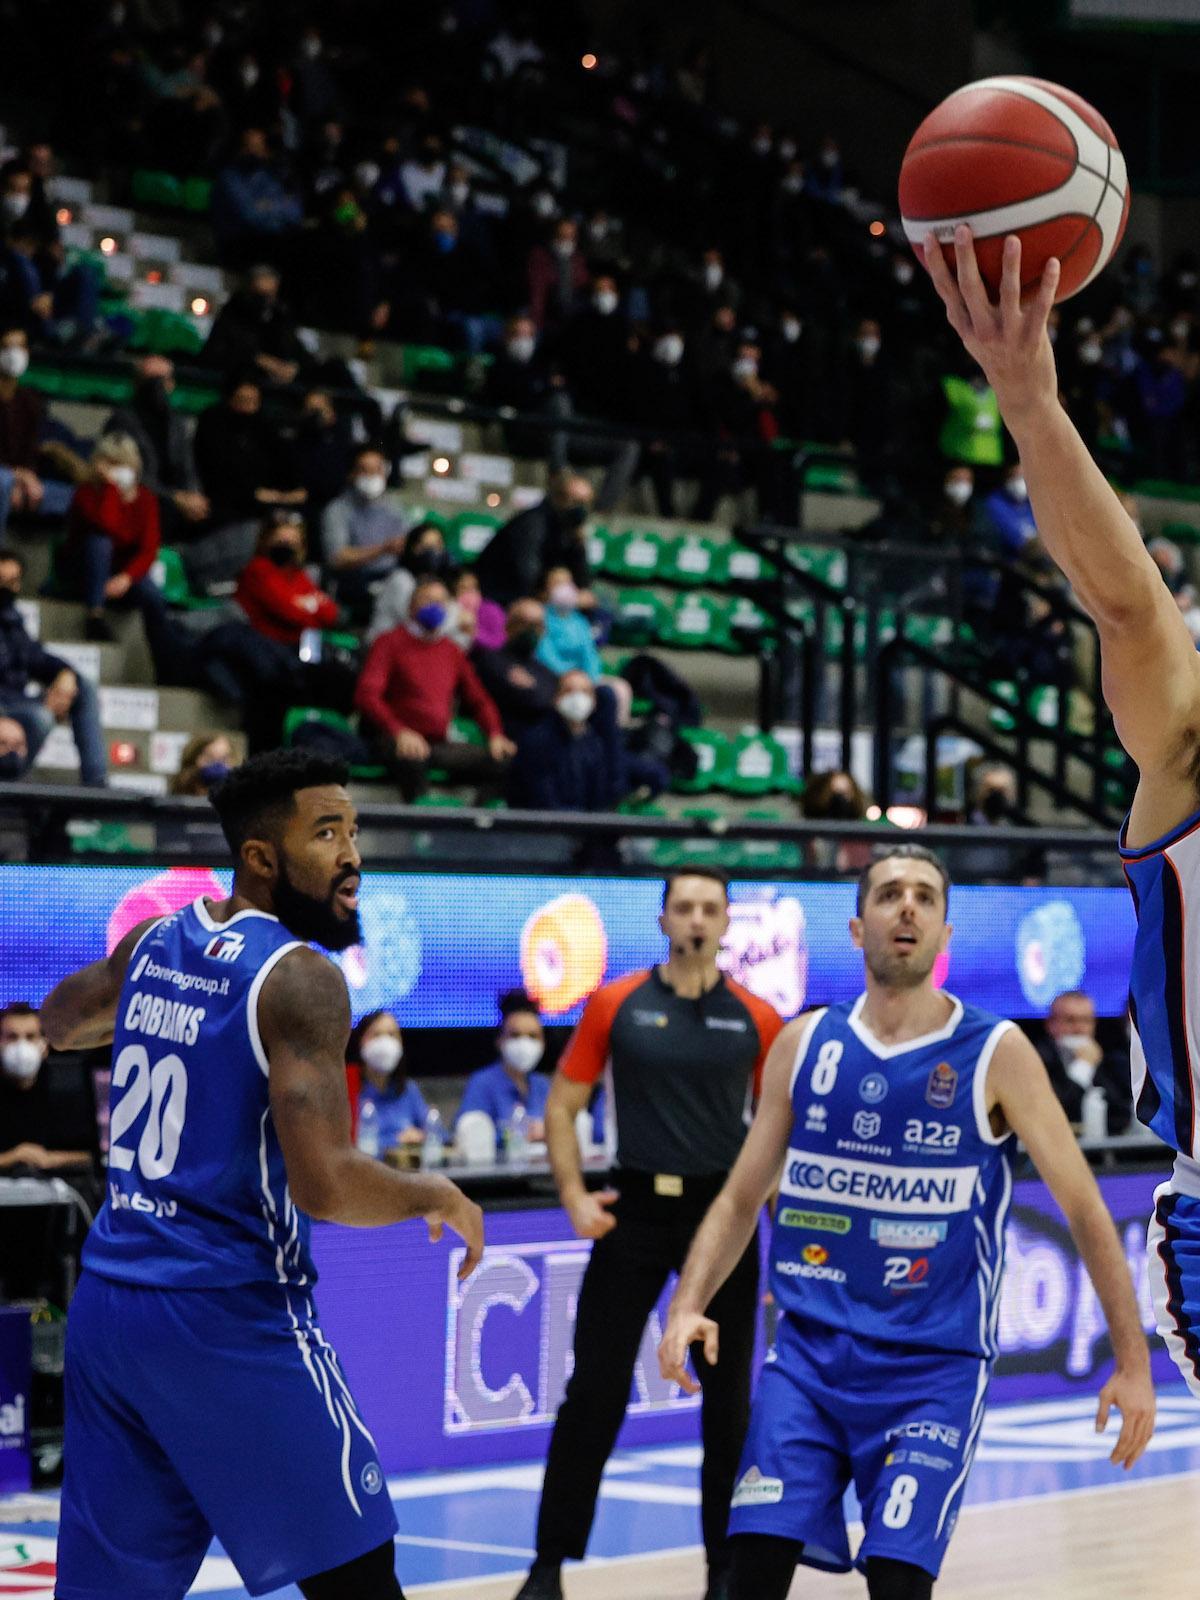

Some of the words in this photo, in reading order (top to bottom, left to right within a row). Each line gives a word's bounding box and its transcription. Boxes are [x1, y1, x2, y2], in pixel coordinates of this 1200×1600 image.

[123, 991, 207, 1047] COBBINS
[810, 1039, 844, 1096] 8
[109, 1044, 188, 1181] 20
[903, 1118, 961, 1147] a2a
[826, 1168, 957, 1204] GERMANI
[881, 1473, 919, 1530] 8
